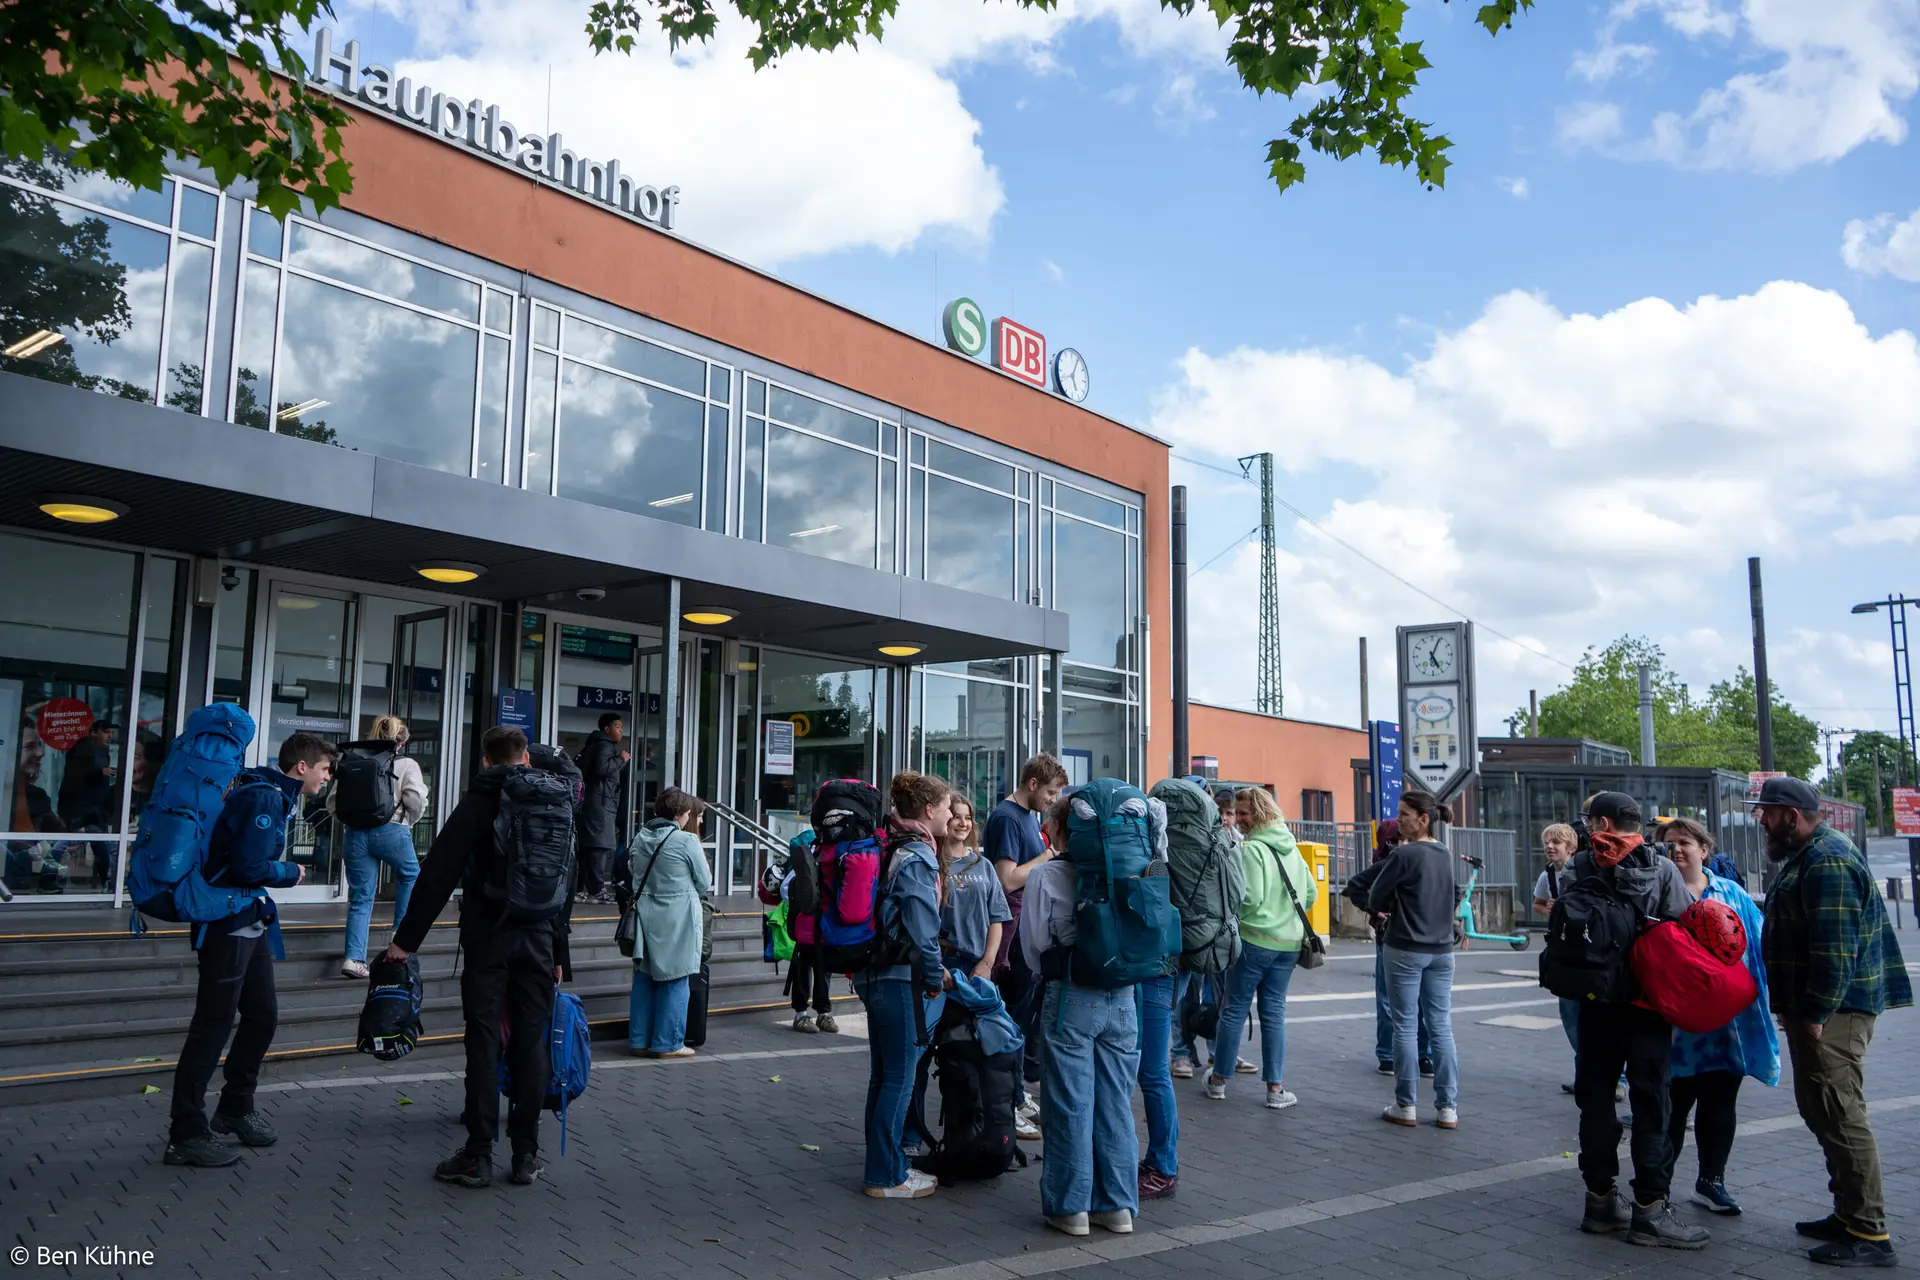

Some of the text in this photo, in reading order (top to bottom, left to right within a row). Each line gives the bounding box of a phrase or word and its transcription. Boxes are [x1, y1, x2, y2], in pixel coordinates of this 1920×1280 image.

[312, 26, 680, 230] Hauptbahnhof
[956, 302, 982, 351] S
[1005, 327, 1041, 375] DB
[595, 689, 603, 703] 3
[52, 718, 80, 726] gesucht!
[278, 718, 344, 729] Herzlich willkommen!
